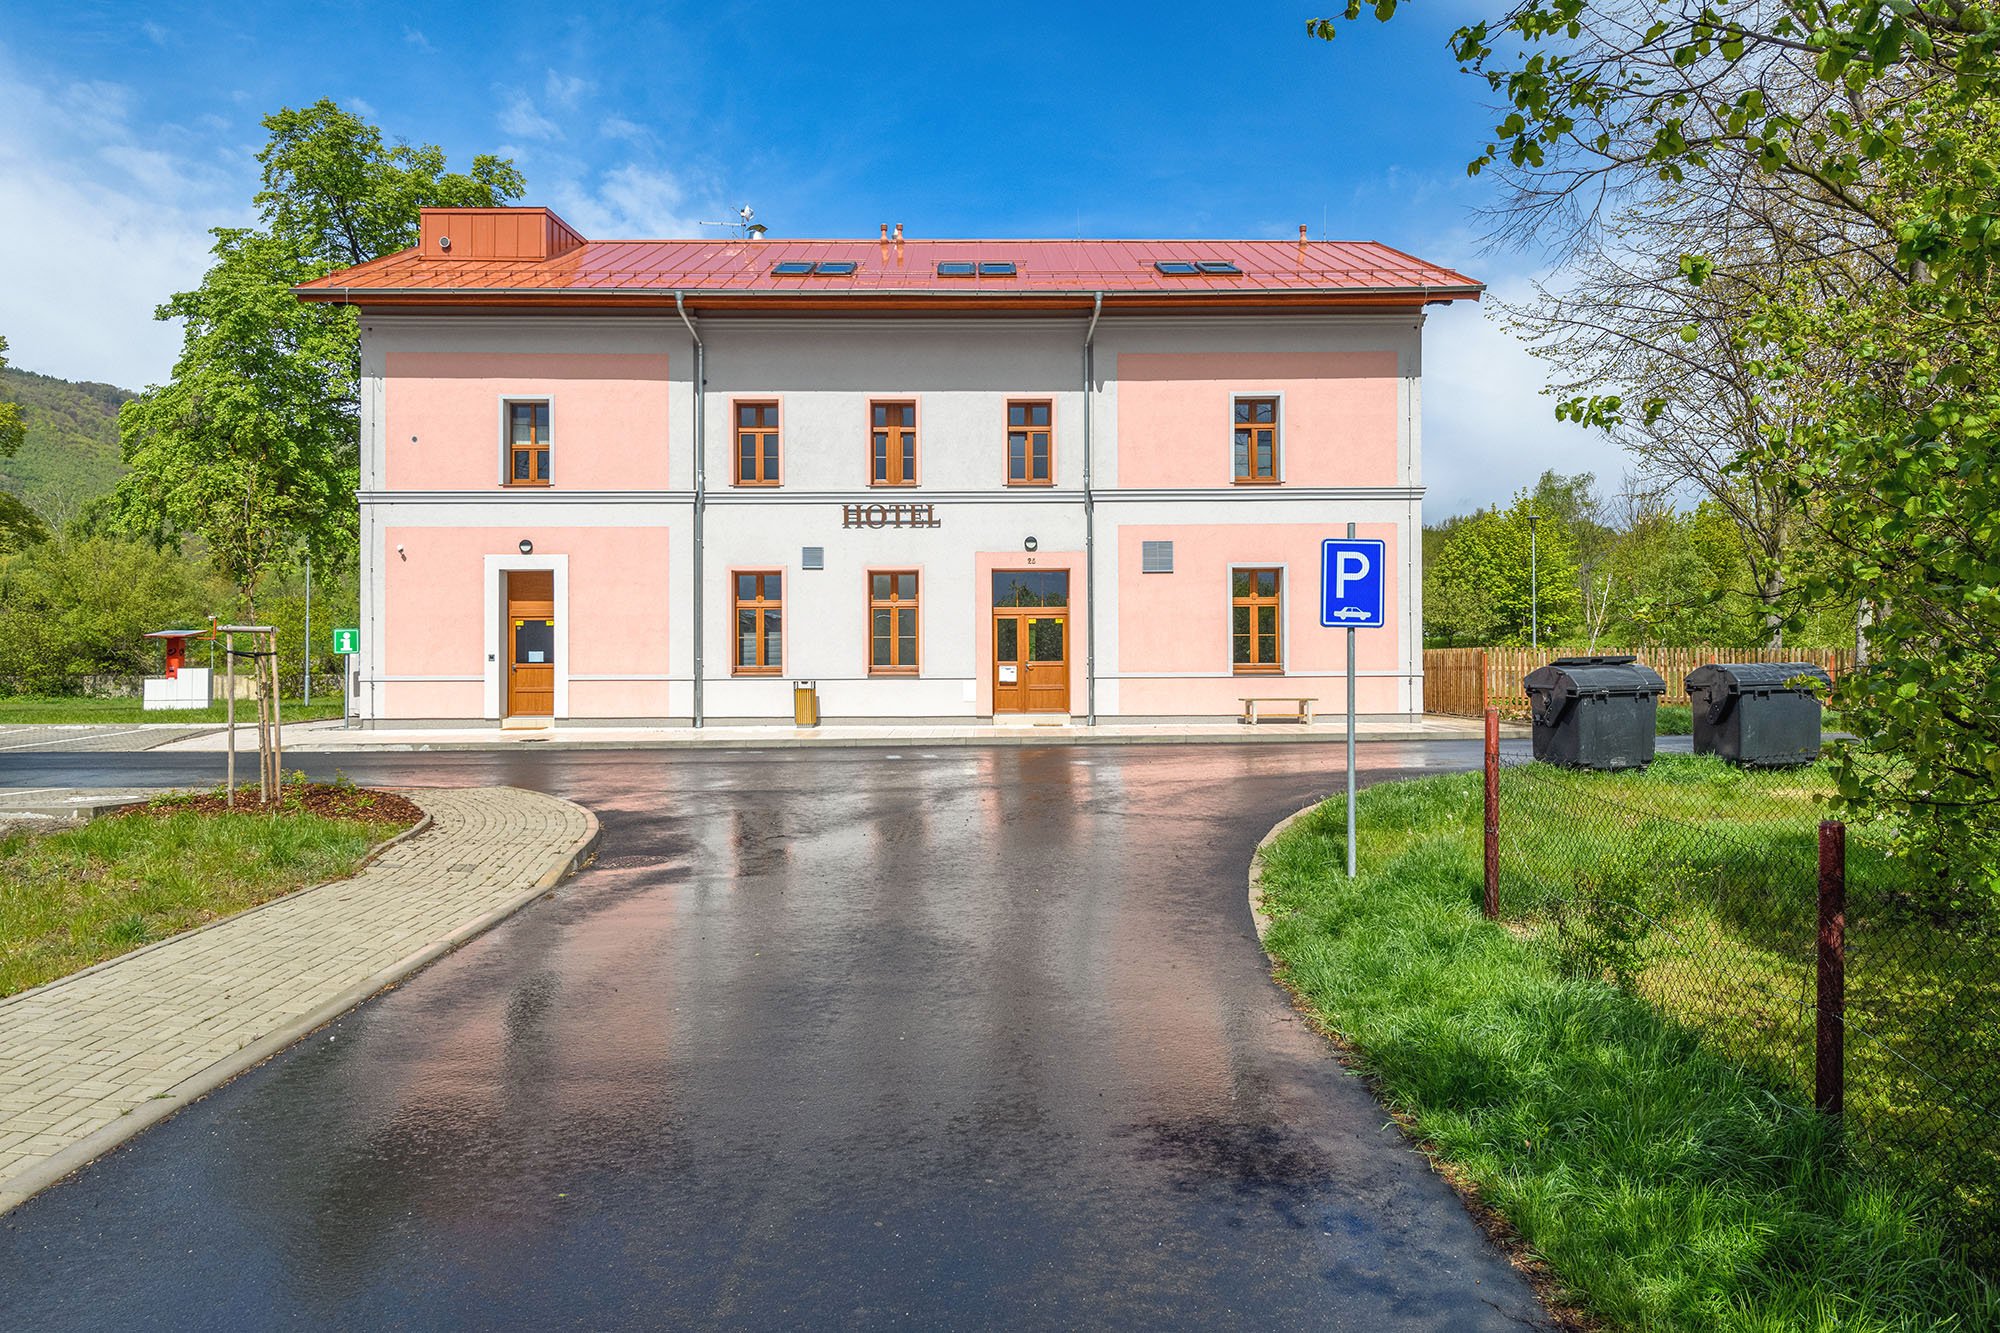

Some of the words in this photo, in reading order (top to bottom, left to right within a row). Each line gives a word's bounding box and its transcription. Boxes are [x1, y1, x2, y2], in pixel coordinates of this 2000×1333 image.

[842, 504, 941, 529] HOTEL
[1336, 551, 1370, 599] P
[340, 631, 353, 651] i
